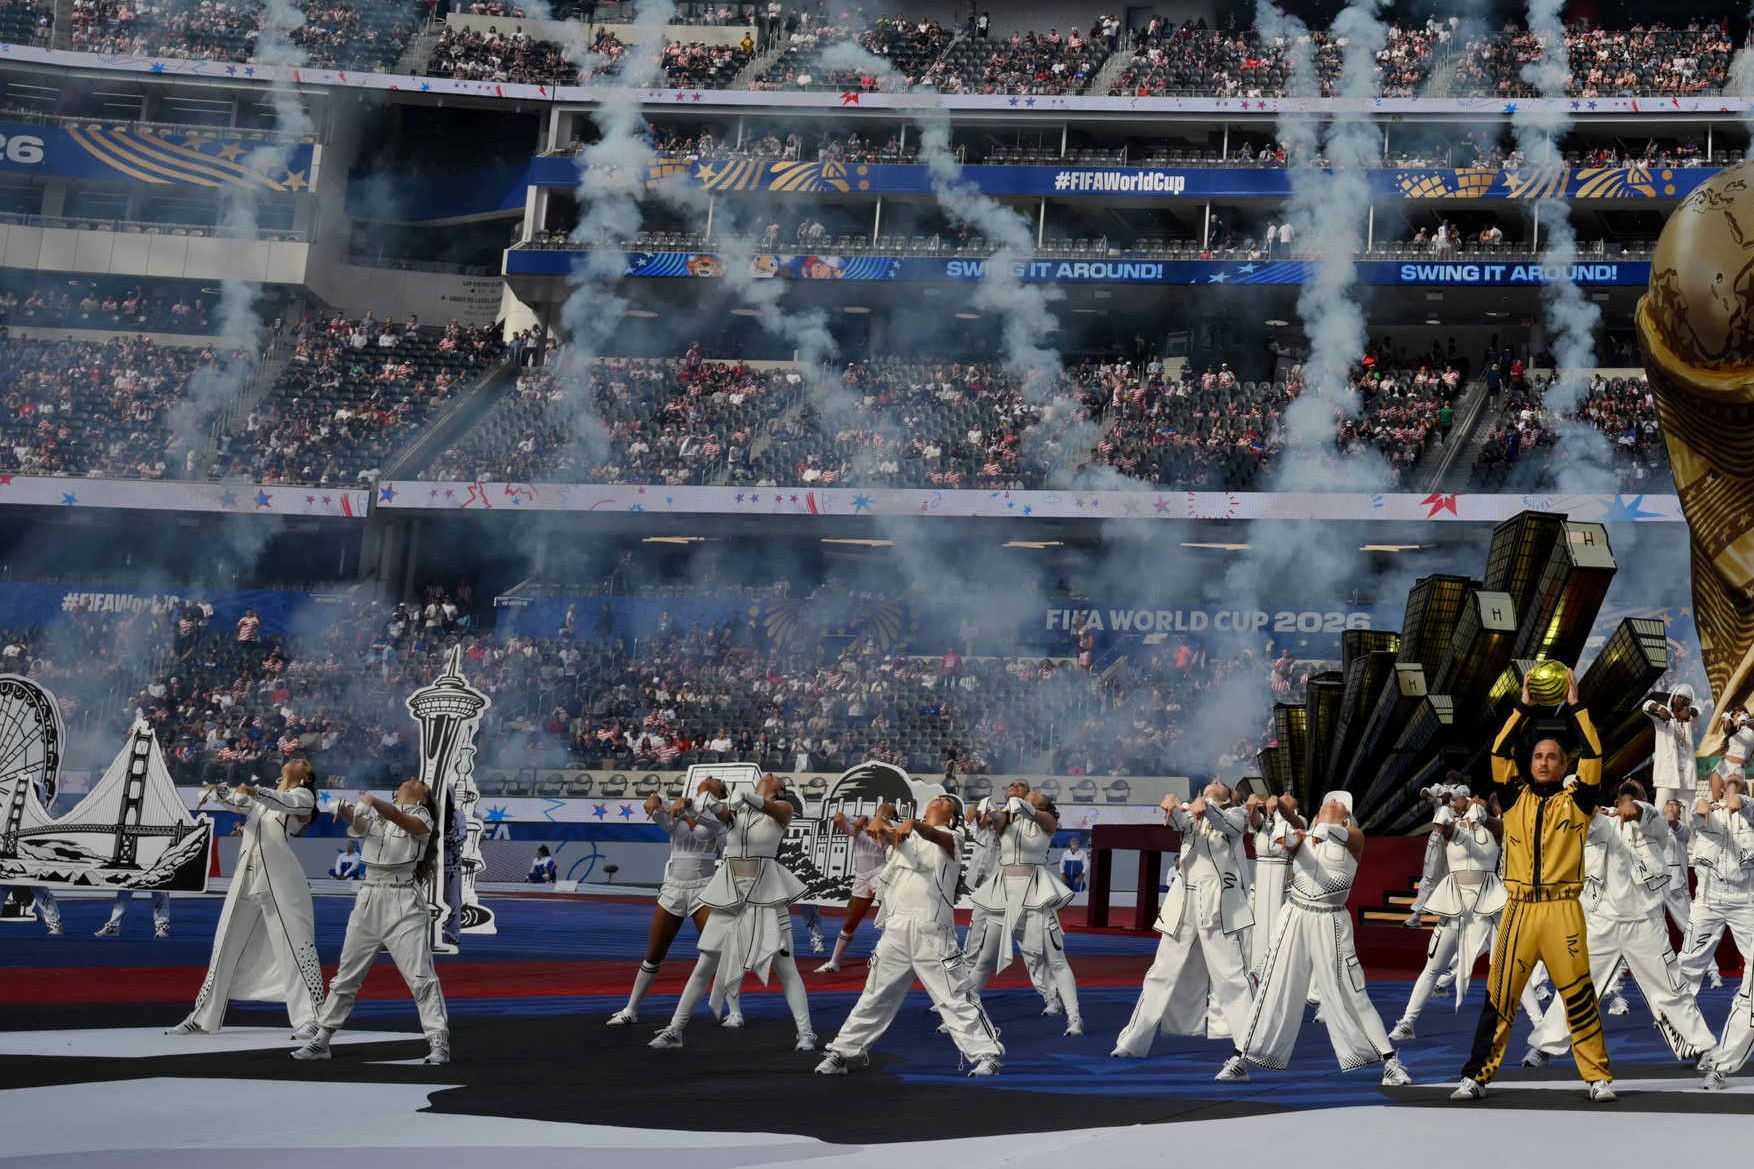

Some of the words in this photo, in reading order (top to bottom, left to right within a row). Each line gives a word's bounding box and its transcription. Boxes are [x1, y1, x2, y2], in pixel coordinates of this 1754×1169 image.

[0, 134, 44, 164] 6
[1055, 171, 1185, 195] #FIFAWorldCup
[946, 261, 1024, 277] SWG
[1030, 262, 1051, 277] IT
[1055, 263, 1162, 278] AROUND!
[1401, 265, 1479, 280] SWING
[1484, 265, 1505, 280] IT
[1510, 265, 1617, 280] AROUND!
[1109, 610, 1209, 632] WORLD
[1214, 611, 1272, 632] CUP
[1274, 612, 1370, 632] 2026
